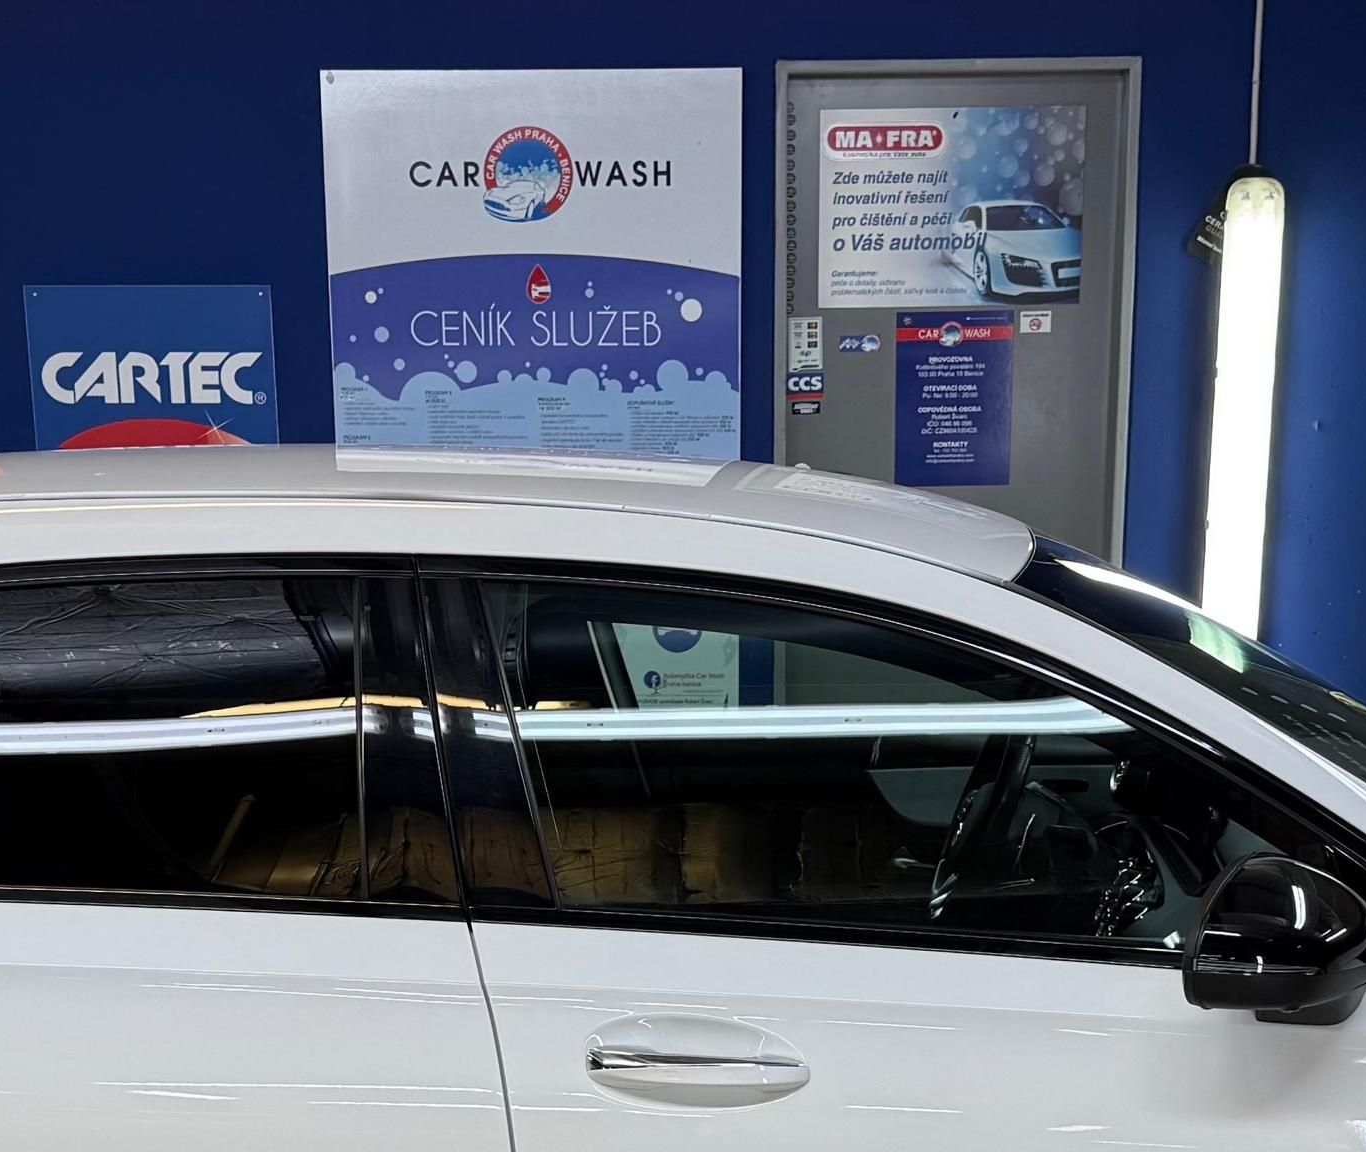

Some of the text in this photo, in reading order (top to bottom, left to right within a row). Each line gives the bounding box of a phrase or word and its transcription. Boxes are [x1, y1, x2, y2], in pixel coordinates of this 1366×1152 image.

[409, 160, 672, 188] CAR WASH
[486, 129, 572, 202] CAR WASH PRAHA BENICE
[833, 170, 948, 186] Zde můžete najít
[905, 190, 950, 204] řešení
[832, 213, 952, 230] pro čištění a péči
[833, 238, 845, 251] o
[851, 233, 884, 251] Váš
[410, 303, 662, 347] CENÍK SLUŽEB
[917, 328, 991, 340] CAR WASH
[788, 376, 822, 391] CCS
